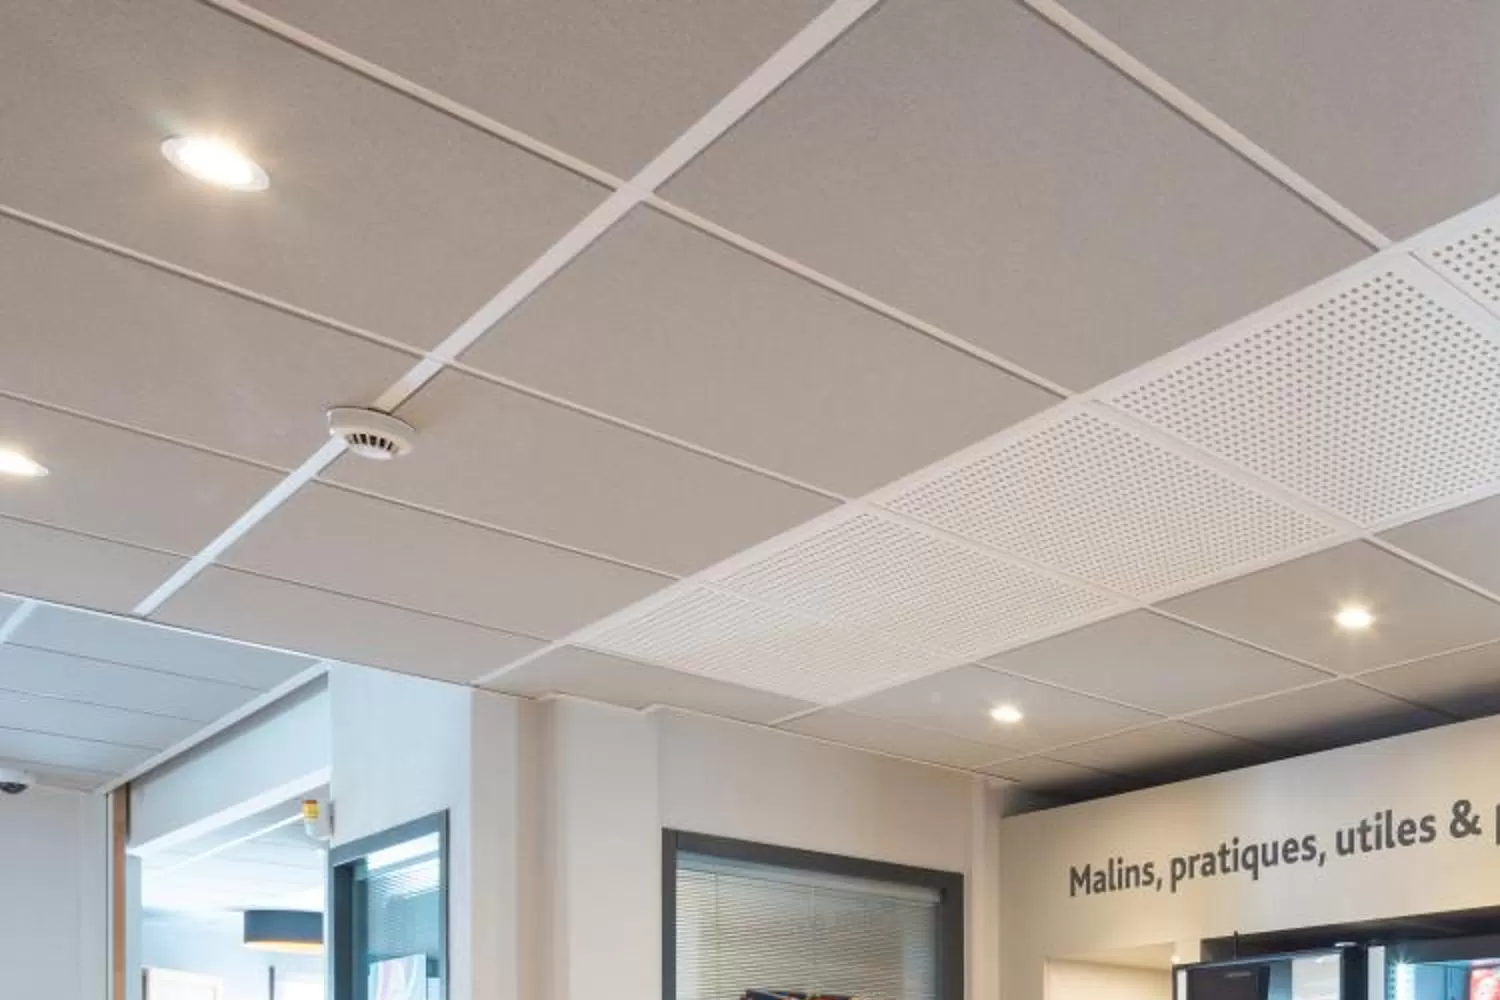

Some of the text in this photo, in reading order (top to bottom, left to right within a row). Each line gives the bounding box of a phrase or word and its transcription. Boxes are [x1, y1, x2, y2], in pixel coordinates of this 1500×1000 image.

[1069, 858, 1164, 897] Malins,
[1170, 836, 1326, 893] pratiques,
[1335, 809, 1437, 857] utiles
[1449, 799, 1482, 839] &
